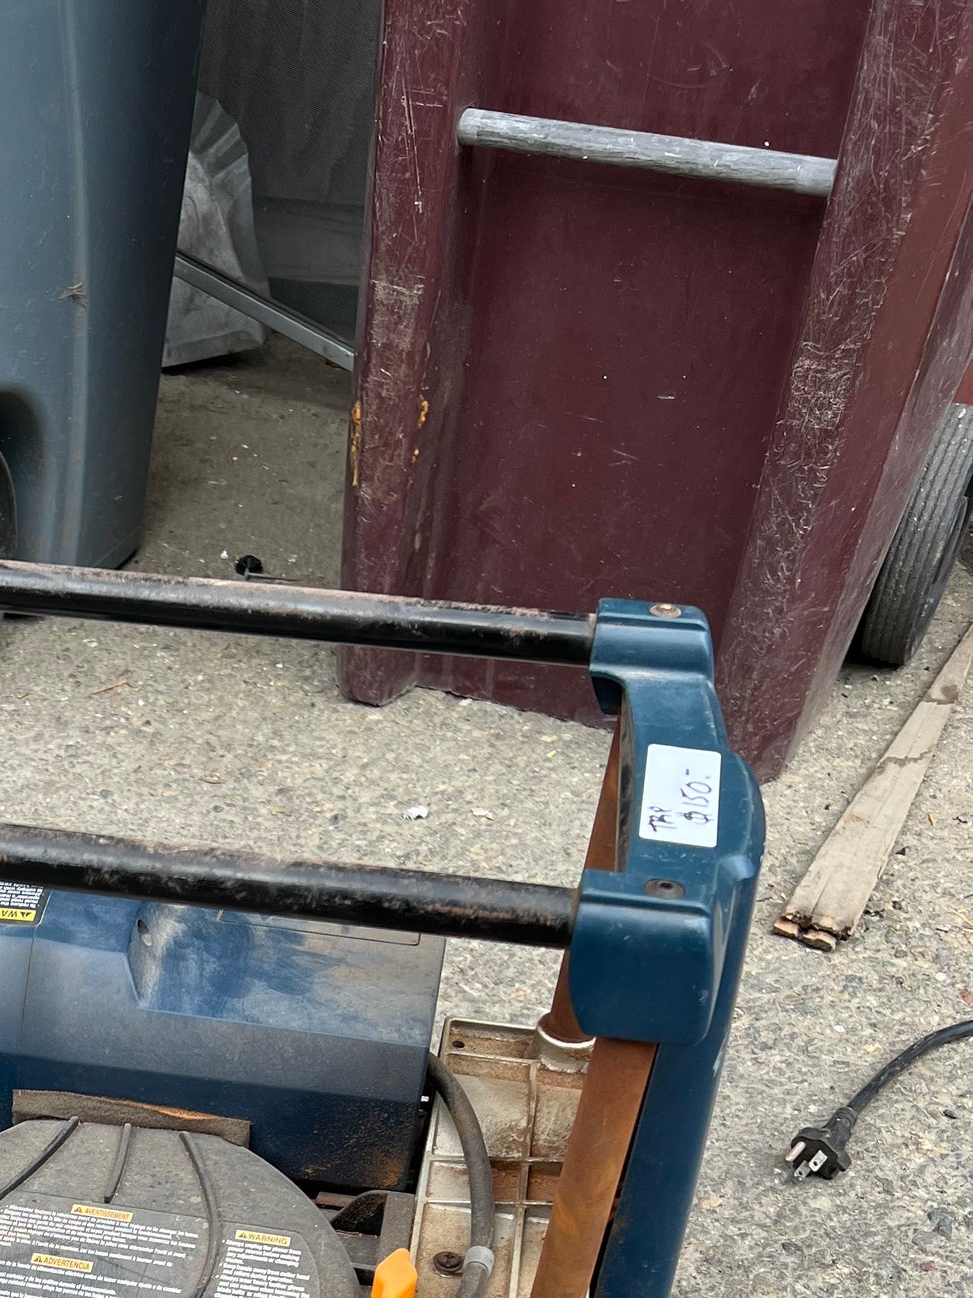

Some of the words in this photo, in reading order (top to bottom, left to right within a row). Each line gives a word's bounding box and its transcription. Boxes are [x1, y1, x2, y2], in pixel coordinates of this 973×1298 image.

[84, 1207, 131, 1220] AVERTISSEMENT
[247, 1233, 288, 1246] WARNING
[43, 1258, 90, 1271] ADVERTENCIA
